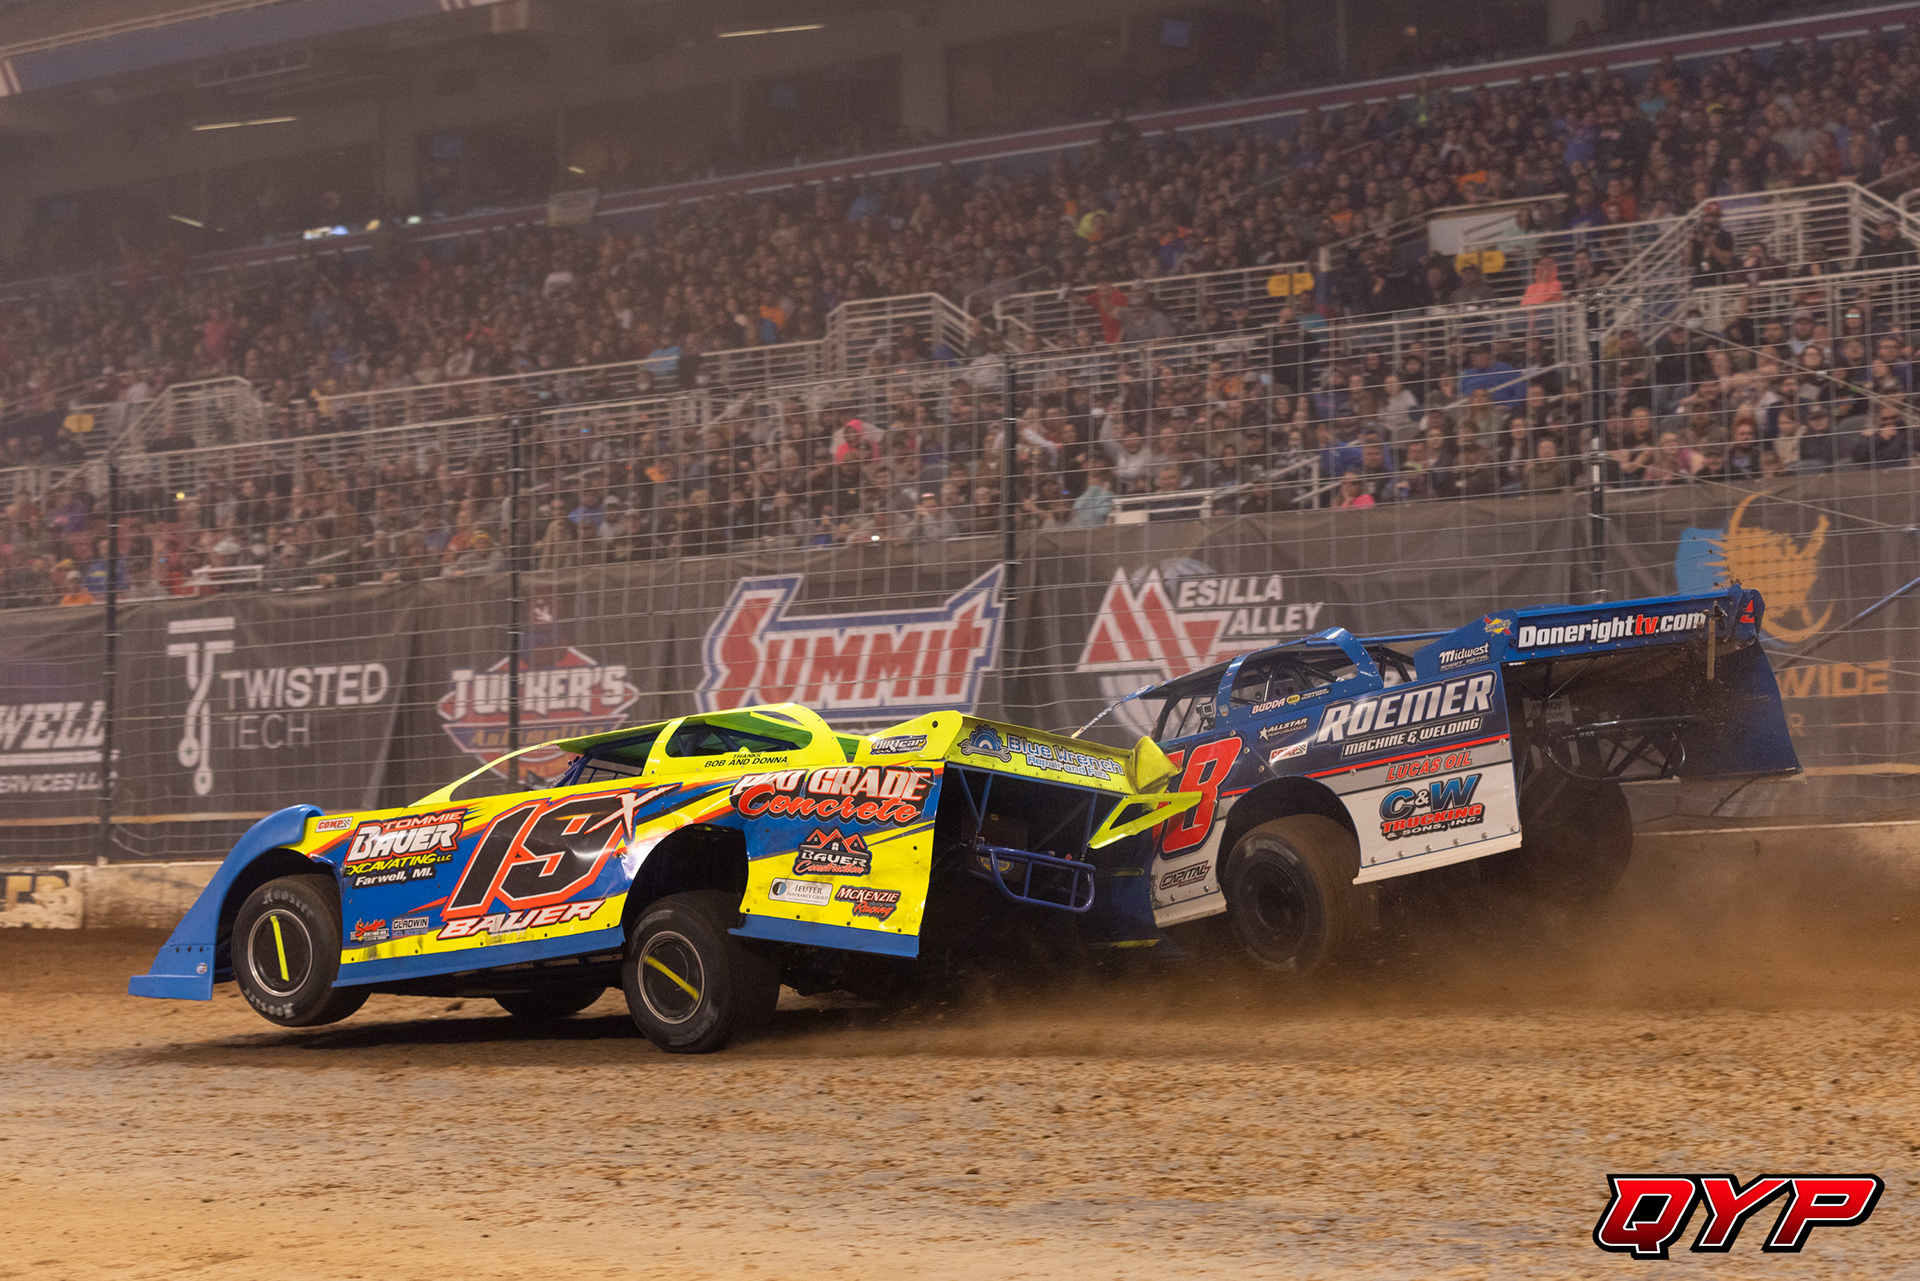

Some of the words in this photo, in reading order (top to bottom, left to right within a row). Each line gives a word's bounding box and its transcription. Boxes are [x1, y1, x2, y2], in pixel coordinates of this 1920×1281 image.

[708, 587, 990, 712] SUMMIT
[1438, 642, 1489, 664] Midwest
[220, 663, 389, 710] TWISTED
[1252, 697, 1286, 715] BUDDA
[1317, 674, 1493, 743] ROEMER
[223, 713, 311, 750] TECH
[1268, 718, 1308, 733] ALLSTAR
[1344, 733, 1406, 756] MACHINE
[1407, 731, 1417, 744] &
[1419, 718, 1482, 740] WELDING
[704, 759, 726, 768] BOB
[728, 758, 750, 766] AND
[752, 756, 788, 765] DONNA
[1007, 734, 1053, 760] Blue
[1054, 746, 1124, 775] Wrench
[1026, 755, 1063, 771] Repair
[1386, 757, 1442, 781] LUCAS
[1444, 751, 1472, 769] OIL
[808, 767, 931, 800] GRADE
[738, 784, 922, 821] Concrete
[1380, 774, 1480, 821] C&W
[382, 810, 467, 830] TOMMIE
[1381, 803, 1483, 834] TRUCKING
[346, 822, 459, 863] BAUER
[436, 854, 452, 862] LLC
[794, 860, 865, 874] Construction
[801, 850, 868, 867] BAUER
[355, 871, 406, 887] Farwell,
[1161, 864, 1206, 887] CAPITAL
[437, 899, 606, 940] BAUER
[853, 901, 894, 919] Racing
[393, 918, 428, 929] GLADWIN
